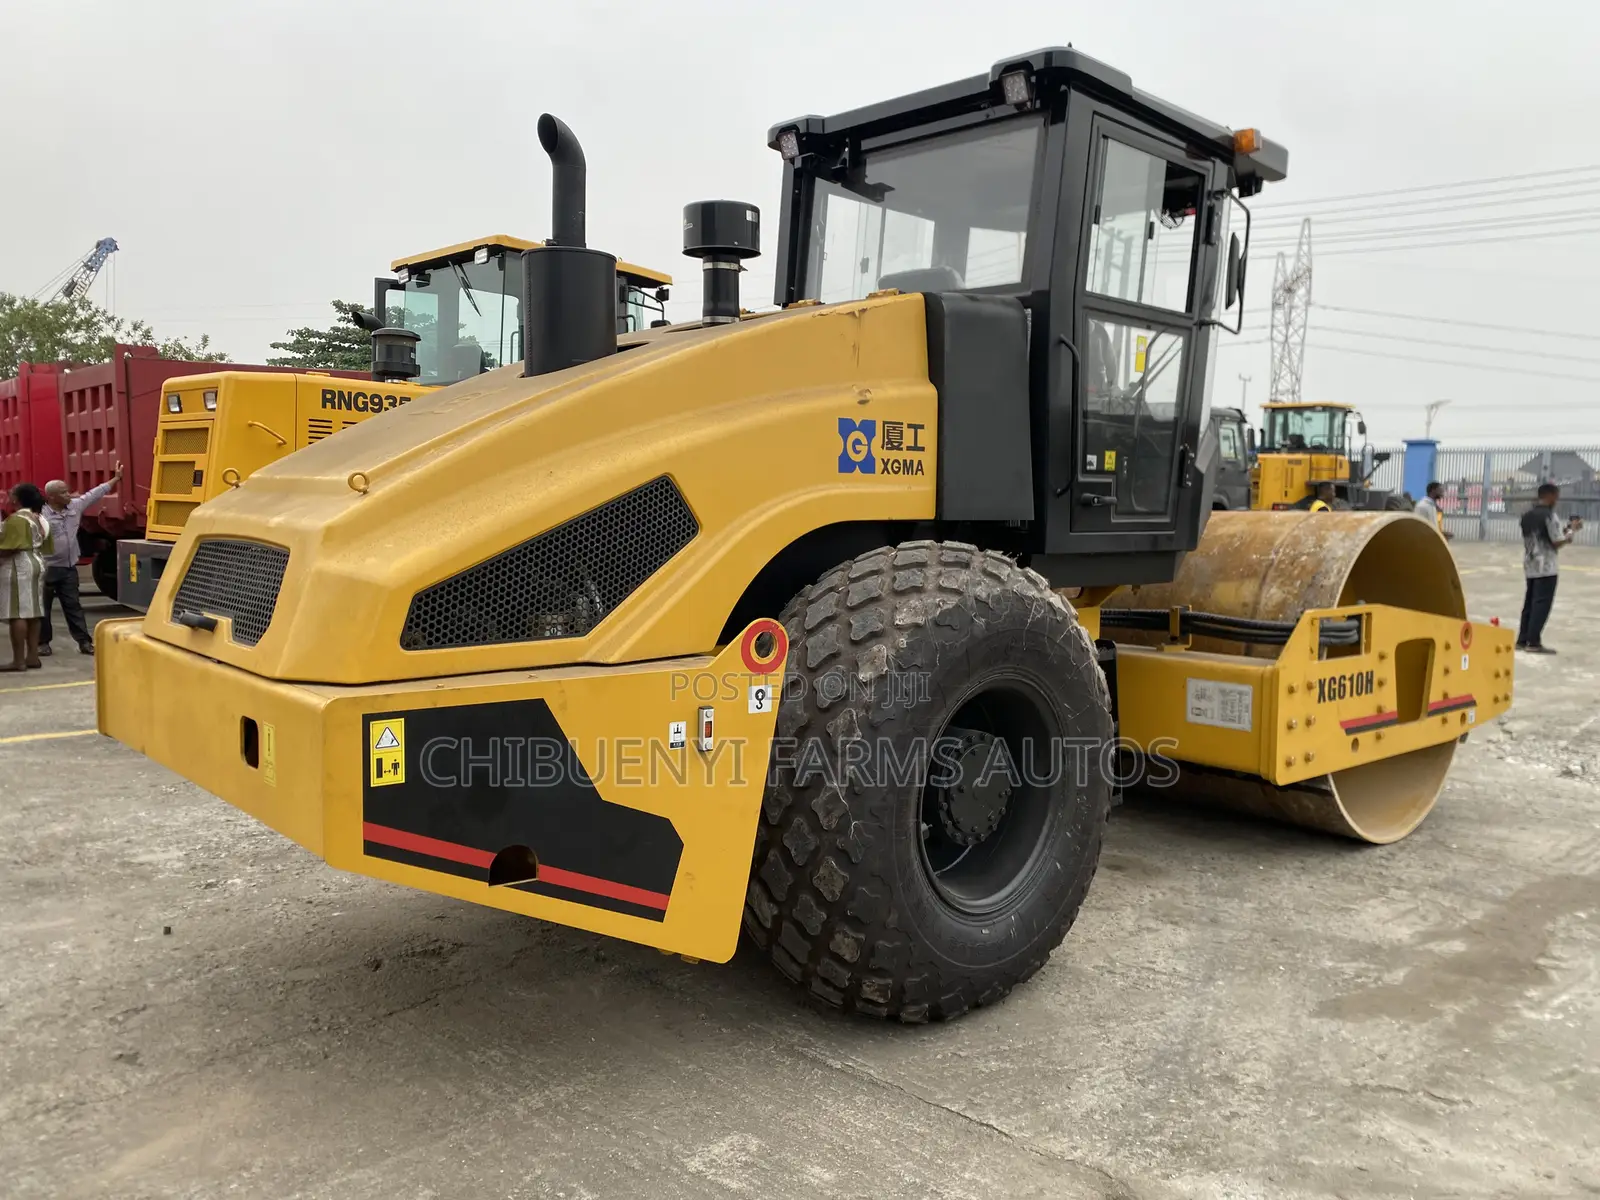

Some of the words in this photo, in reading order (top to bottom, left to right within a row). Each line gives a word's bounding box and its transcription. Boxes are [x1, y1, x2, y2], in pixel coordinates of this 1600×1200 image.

[881, 420, 925, 452] 厦工
[881, 458, 925, 476] XGMA
[1317, 670, 1374, 704] XG610H
